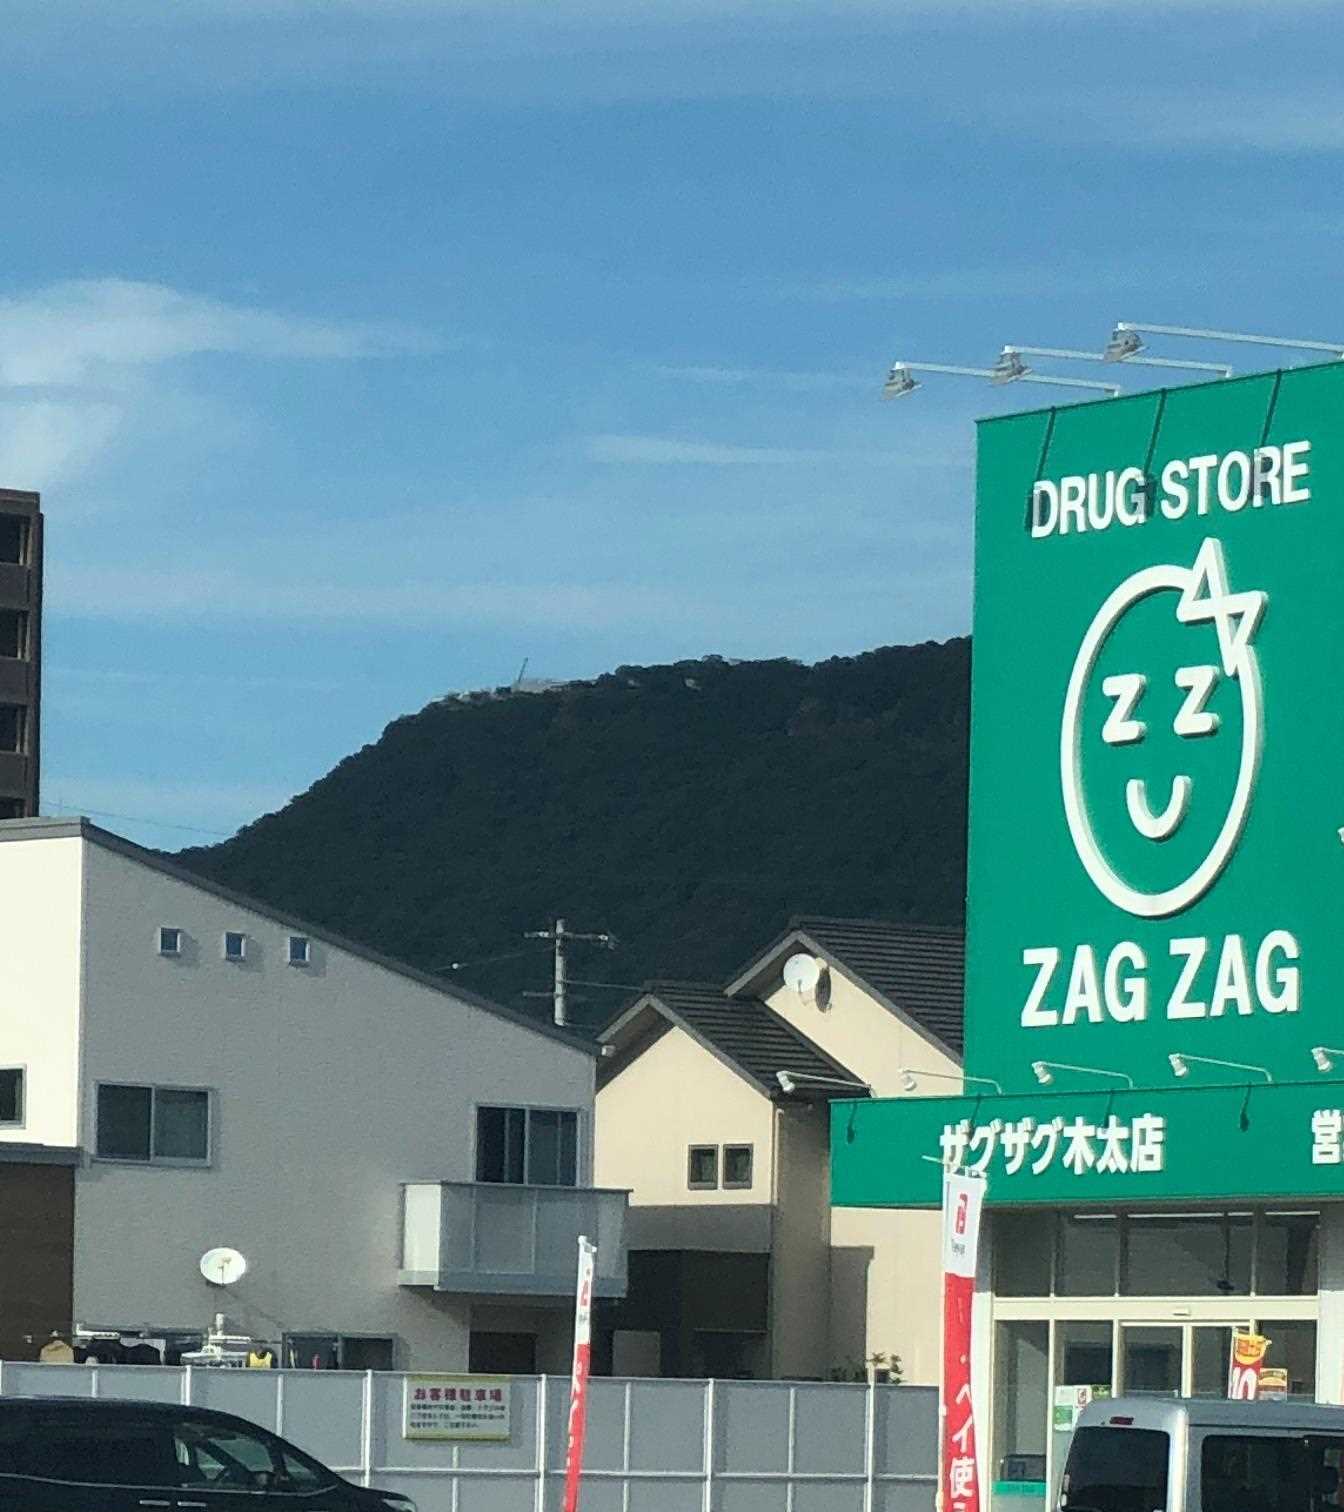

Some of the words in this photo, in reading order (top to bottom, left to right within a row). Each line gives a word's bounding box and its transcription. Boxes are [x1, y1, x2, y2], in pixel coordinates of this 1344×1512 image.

[1030, 468, 1149, 538] DRUG
[1160, 440, 1312, 515] STORE
[1020, 943, 1149, 1028] ZAG
[1166, 929, 1301, 1019] ZAG
[939, 1112, 1165, 1176] ザグザグ木太店
